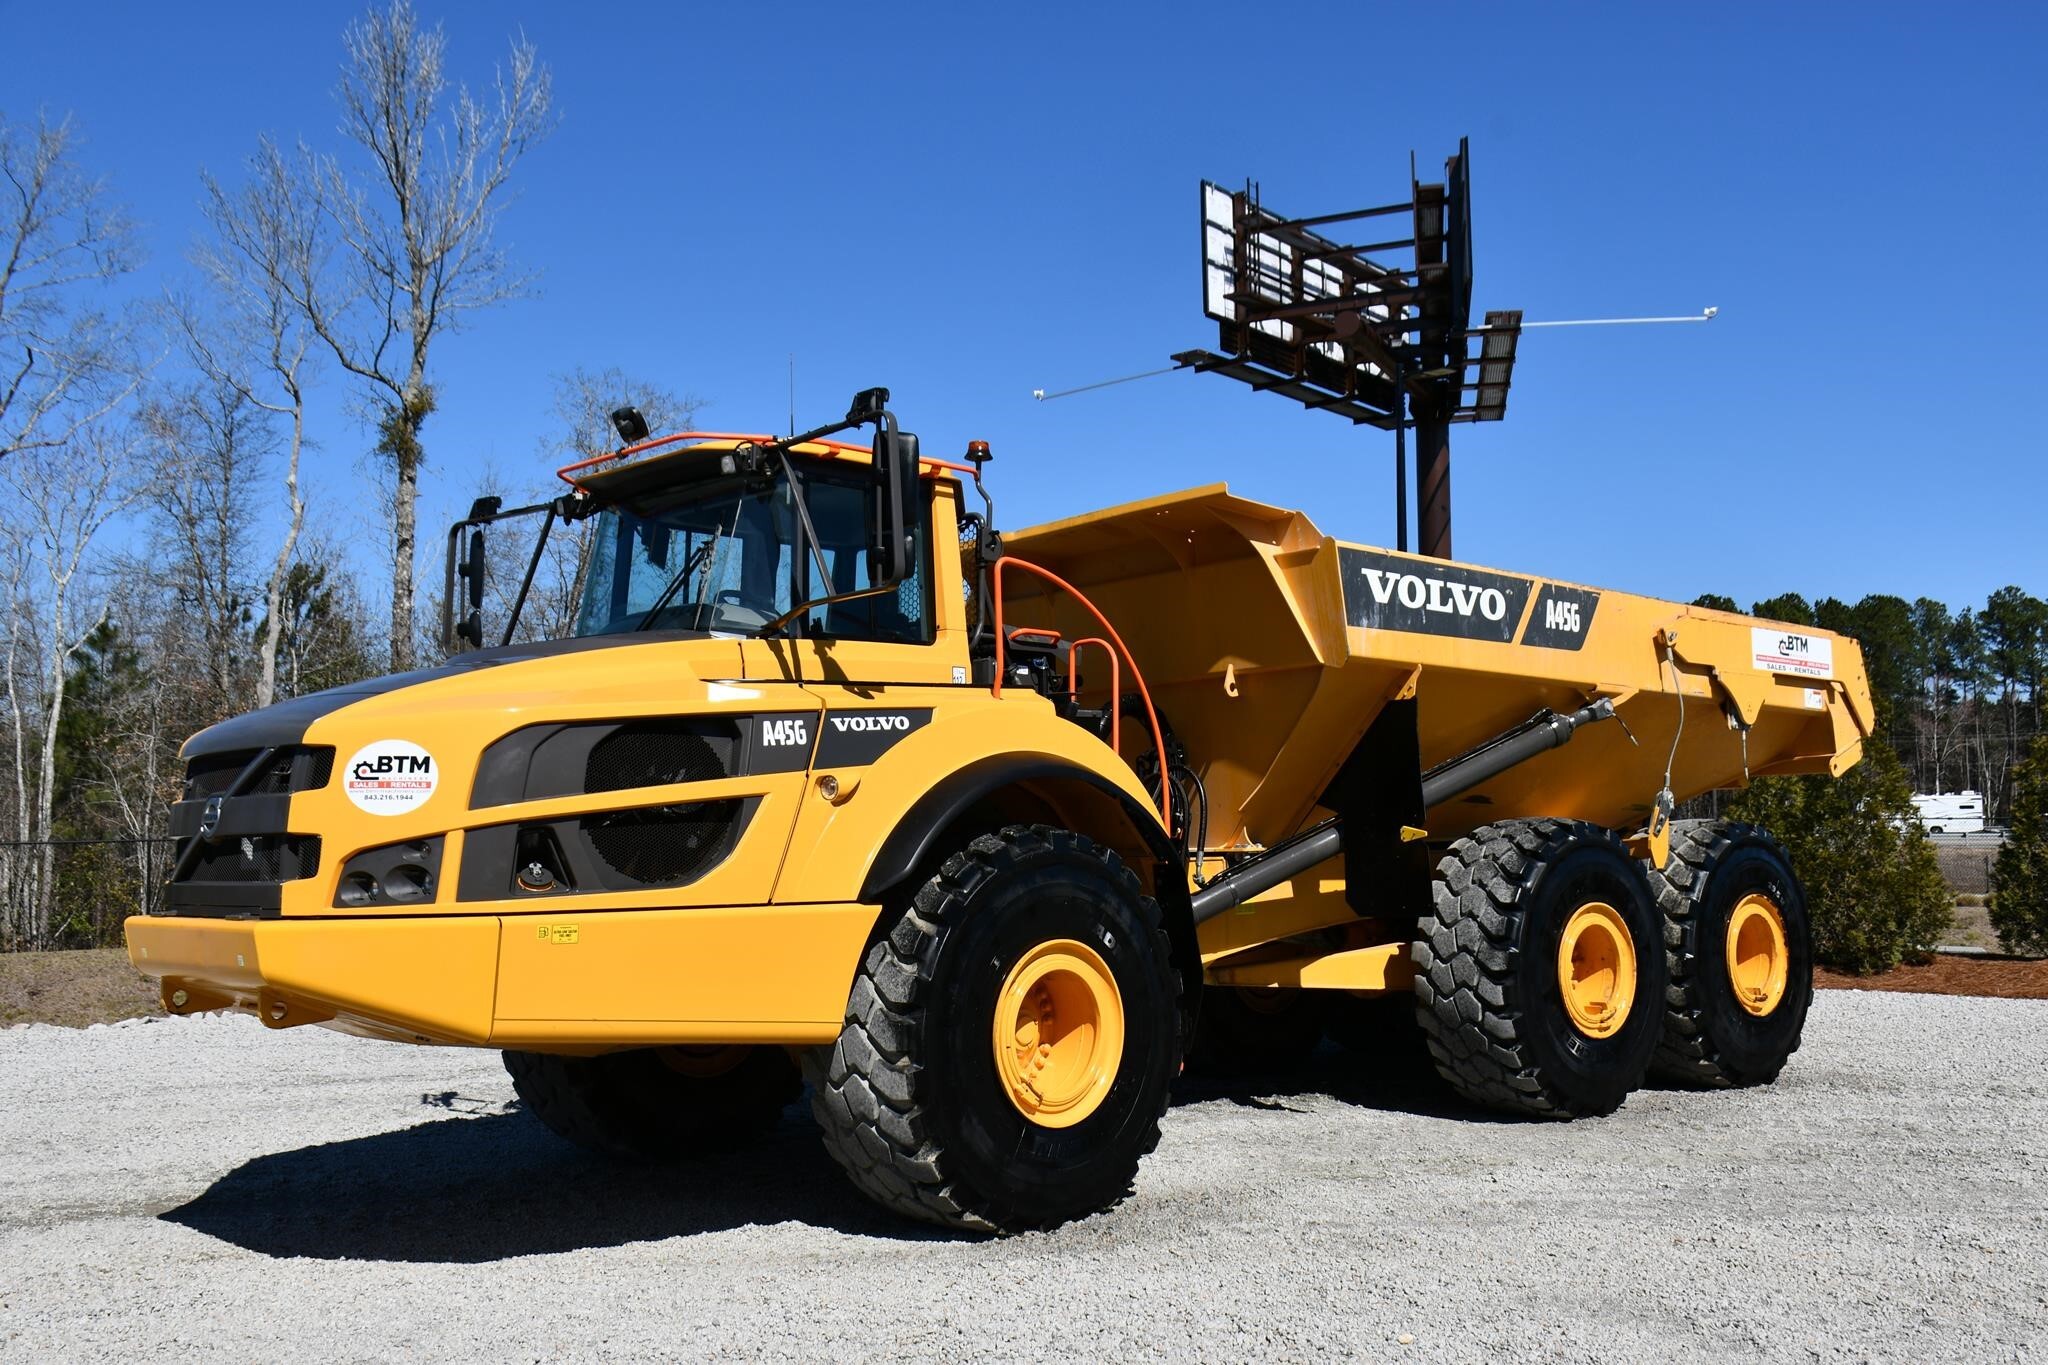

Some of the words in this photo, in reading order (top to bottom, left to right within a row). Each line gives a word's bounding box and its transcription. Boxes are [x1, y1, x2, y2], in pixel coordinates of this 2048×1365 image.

[1361, 567, 1506, 621] VOLVO
[1546, 599, 1580, 633] A45G
[1787, 635, 1808, 652] BTM
[1767, 663, 1786, 671] SALES
[831, 716, 909, 732] VOLVO
[763, 719, 807, 747] A45G
[377, 755, 430, 773] BTM
